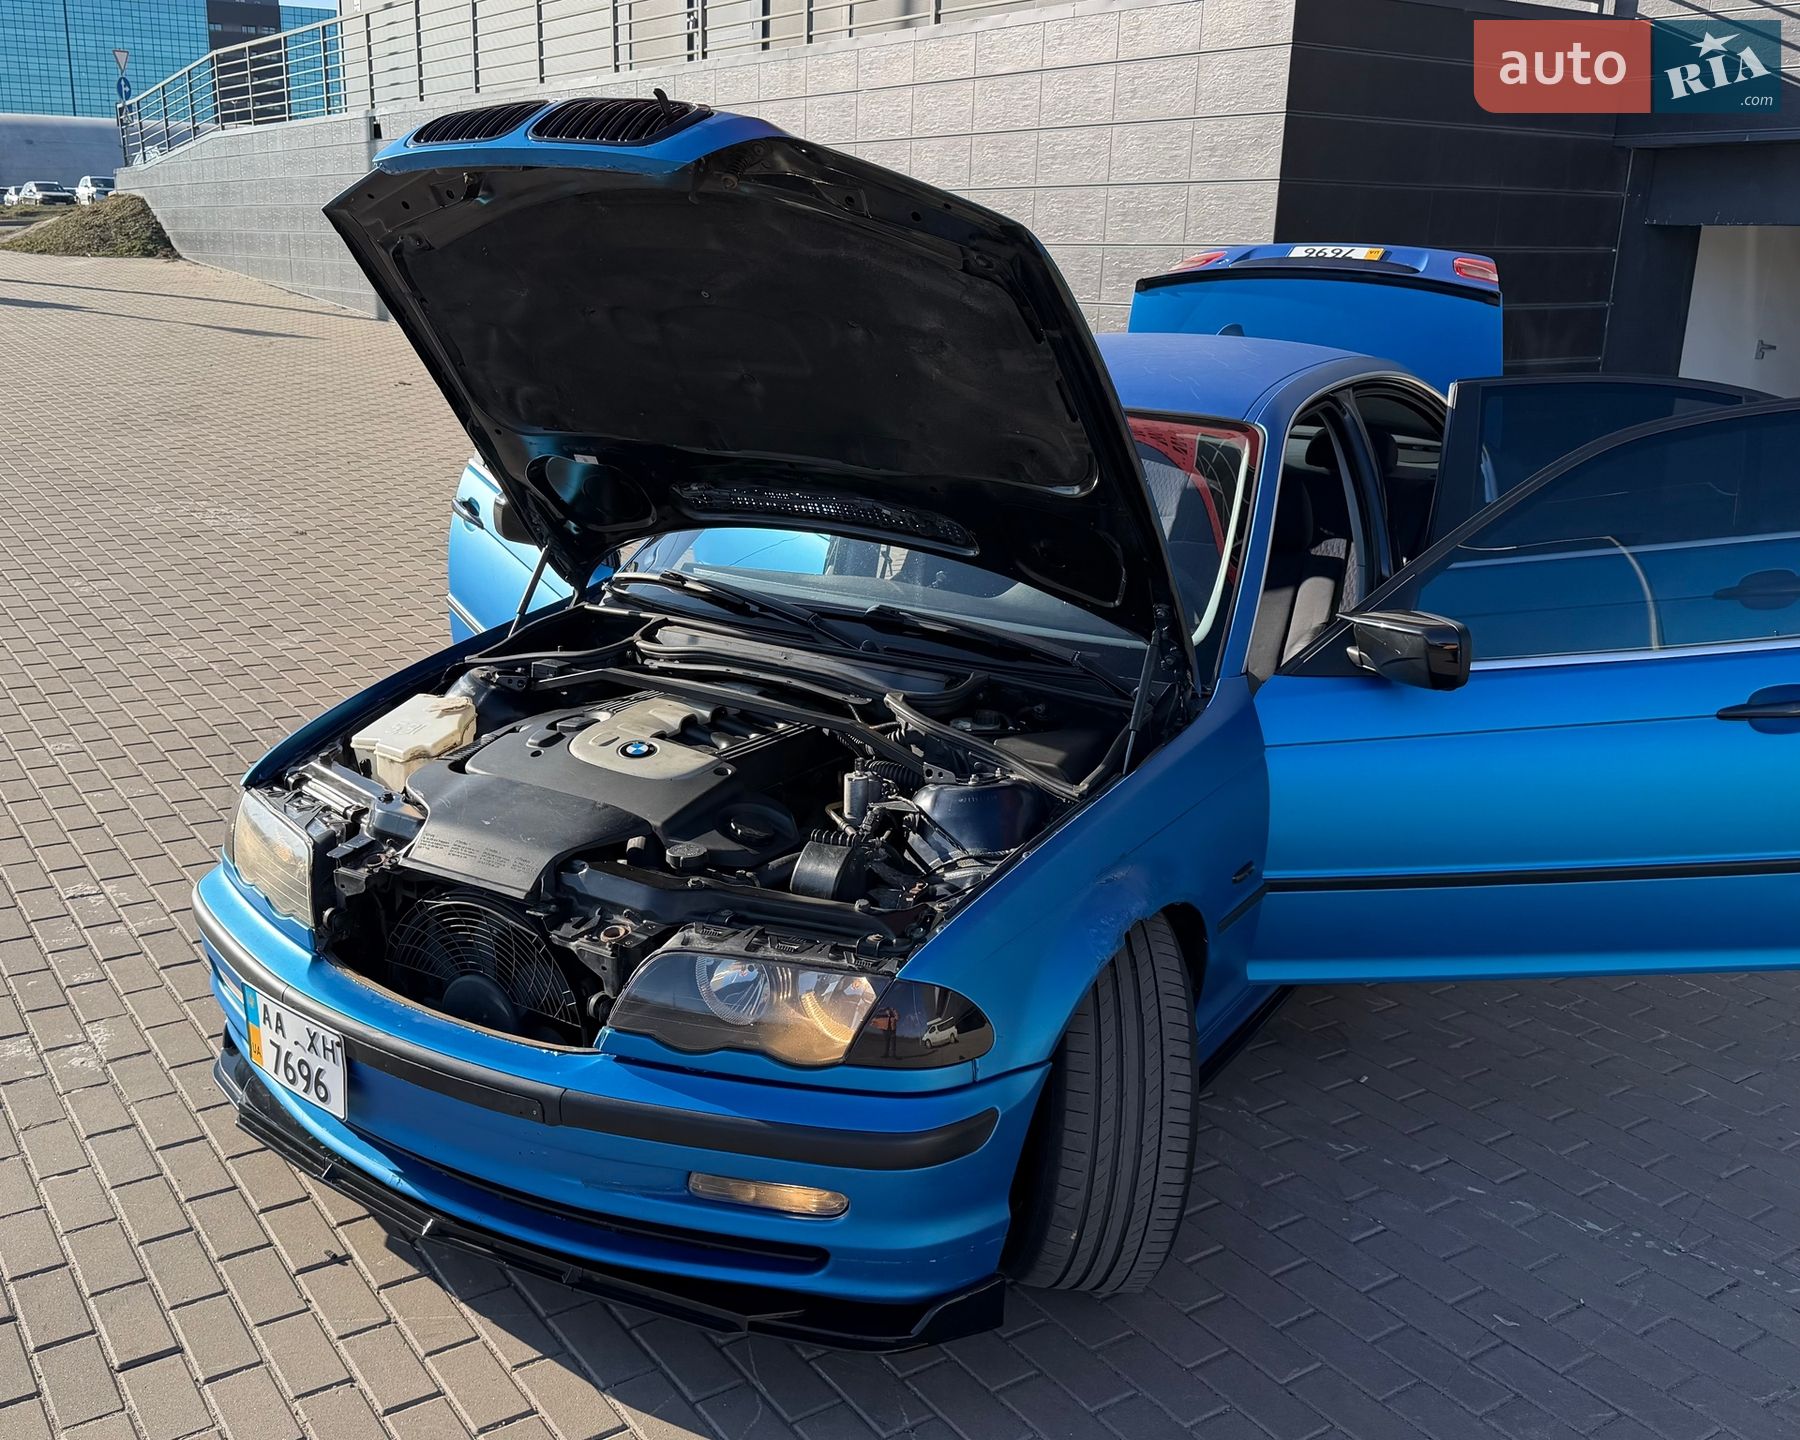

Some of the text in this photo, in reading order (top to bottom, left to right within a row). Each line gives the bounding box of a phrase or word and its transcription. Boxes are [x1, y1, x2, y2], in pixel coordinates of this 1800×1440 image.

[1304, 248, 1355, 258] 7696
[252, 1042, 262, 1058] UA
[263, 1003, 336, 1065] AA XH
[269, 1039, 328, 1103] 7696
